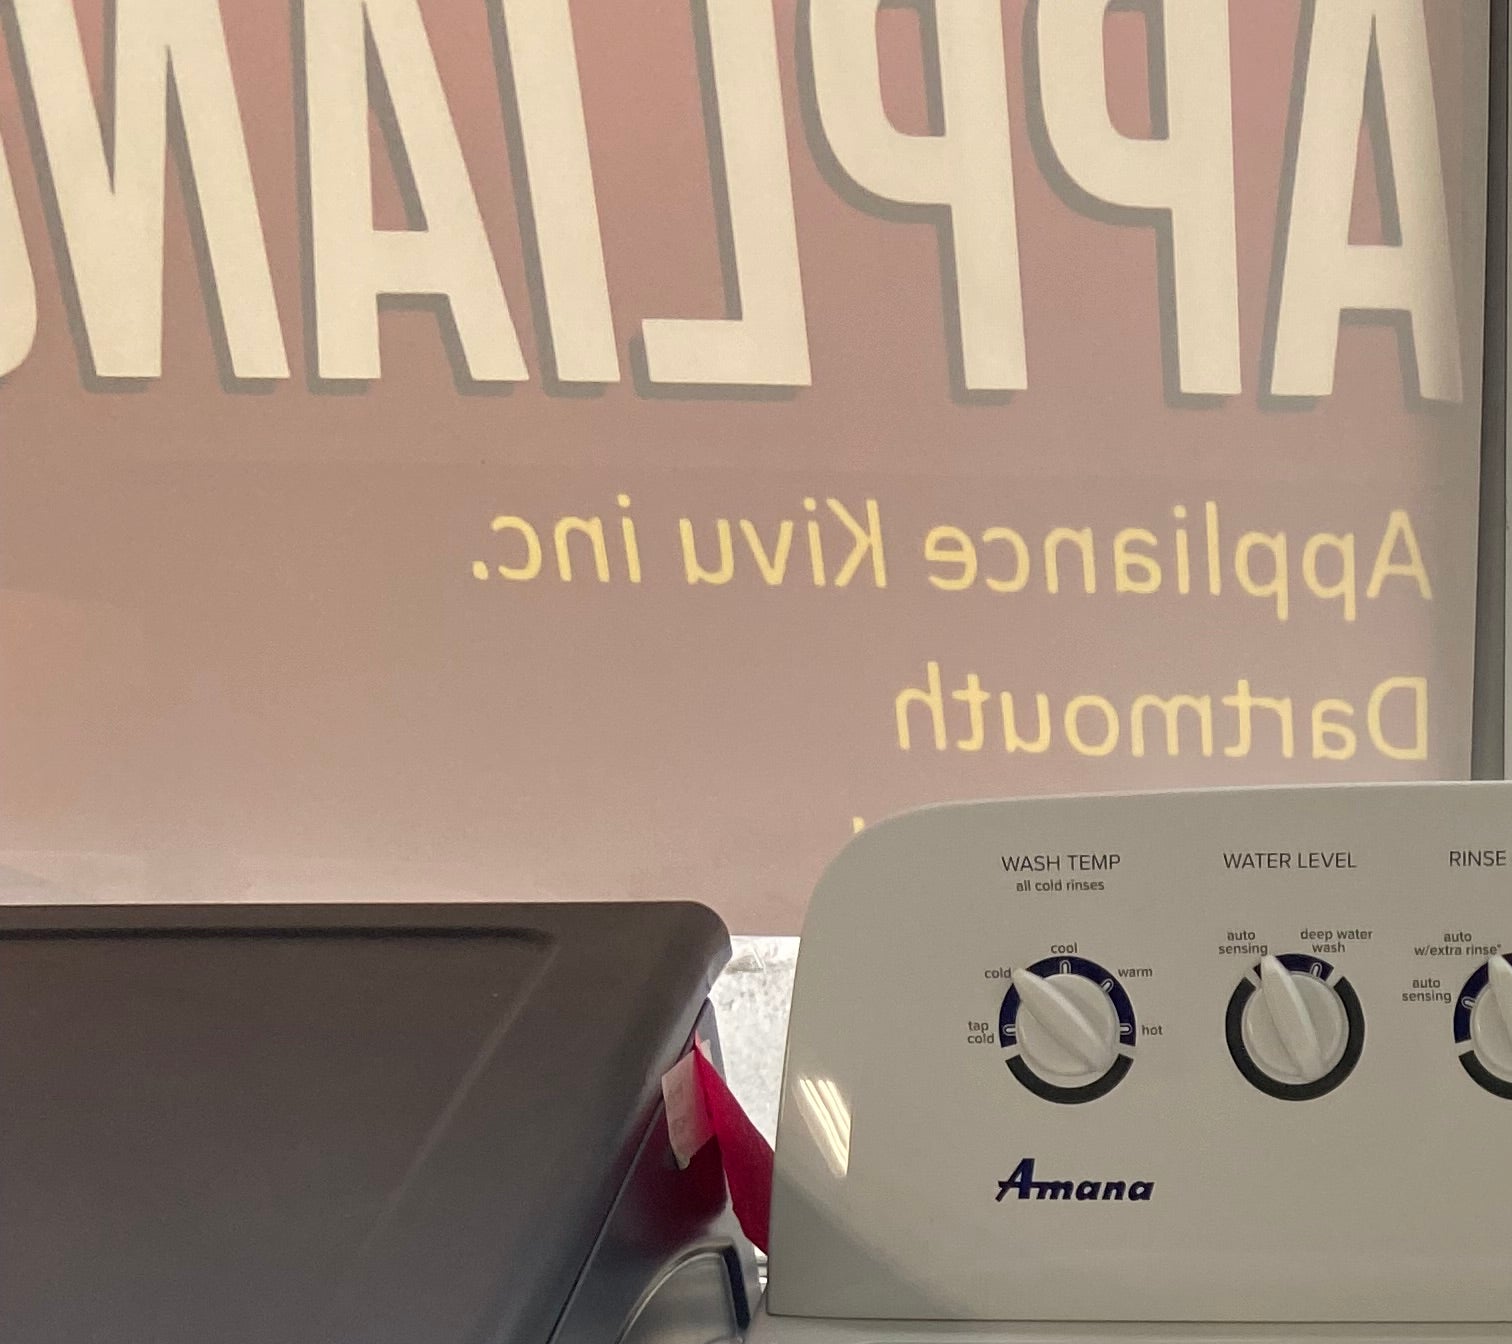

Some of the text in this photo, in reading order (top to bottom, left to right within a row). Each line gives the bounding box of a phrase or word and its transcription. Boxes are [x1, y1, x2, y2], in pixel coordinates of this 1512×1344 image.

[1001, 854, 1121, 872] WASH TEMP
[1223, 852, 1357, 869] WATER LEVEL
[1449, 850, 1507, 867] RINSE
[1016, 879, 1105, 892] all cold rinses
[1227, 930, 1256, 941] auto
[1300, 928, 1373, 942] deep water
[1444, 931, 1472, 942] auto
[1050, 942, 1078, 954] cool
[1218, 943, 1268, 956] sensing
[1312, 942, 1346, 953] wash
[1414, 944, 1462, 956] w/extra
[984, 967, 1012, 979] cold
[1118, 968, 1153, 978] warm
[1412, 978, 1441, 989] auto
[1402, 990, 1452, 1004] sensing
[968, 1020, 989, 1032] tap
[1142, 1024, 1163, 1036] hot
[967, 1033, 995, 1044] cold
[995, 1158, 1155, 1202] Amana
